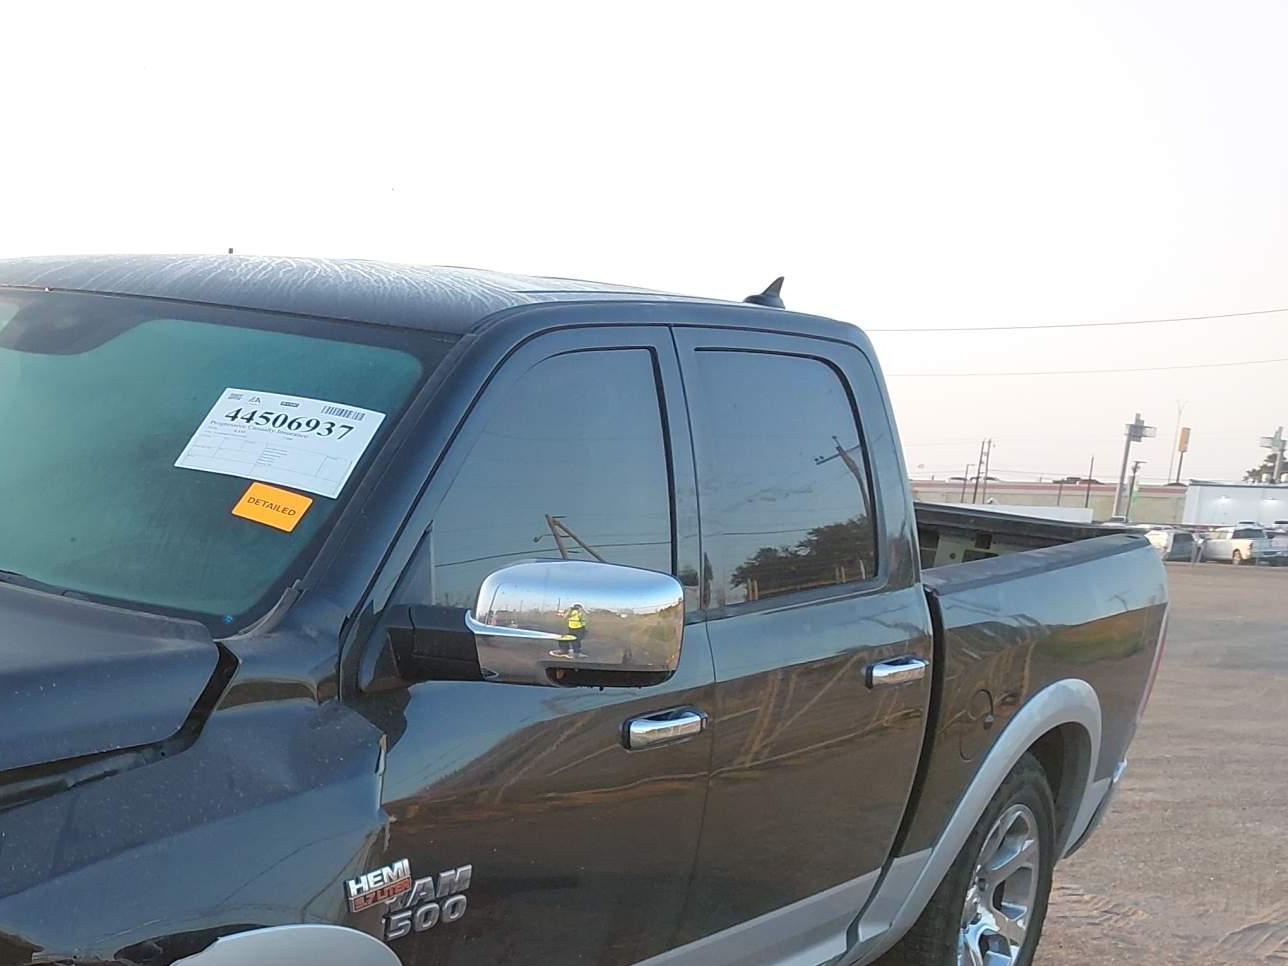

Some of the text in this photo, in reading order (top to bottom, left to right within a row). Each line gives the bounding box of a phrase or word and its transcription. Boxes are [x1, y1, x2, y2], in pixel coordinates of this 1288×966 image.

[224, 407, 354, 441] 44506937
[247, 496, 296, 517] DETAILED
[348, 858, 411, 897] HEMI
[381, 894, 468, 941] 500
